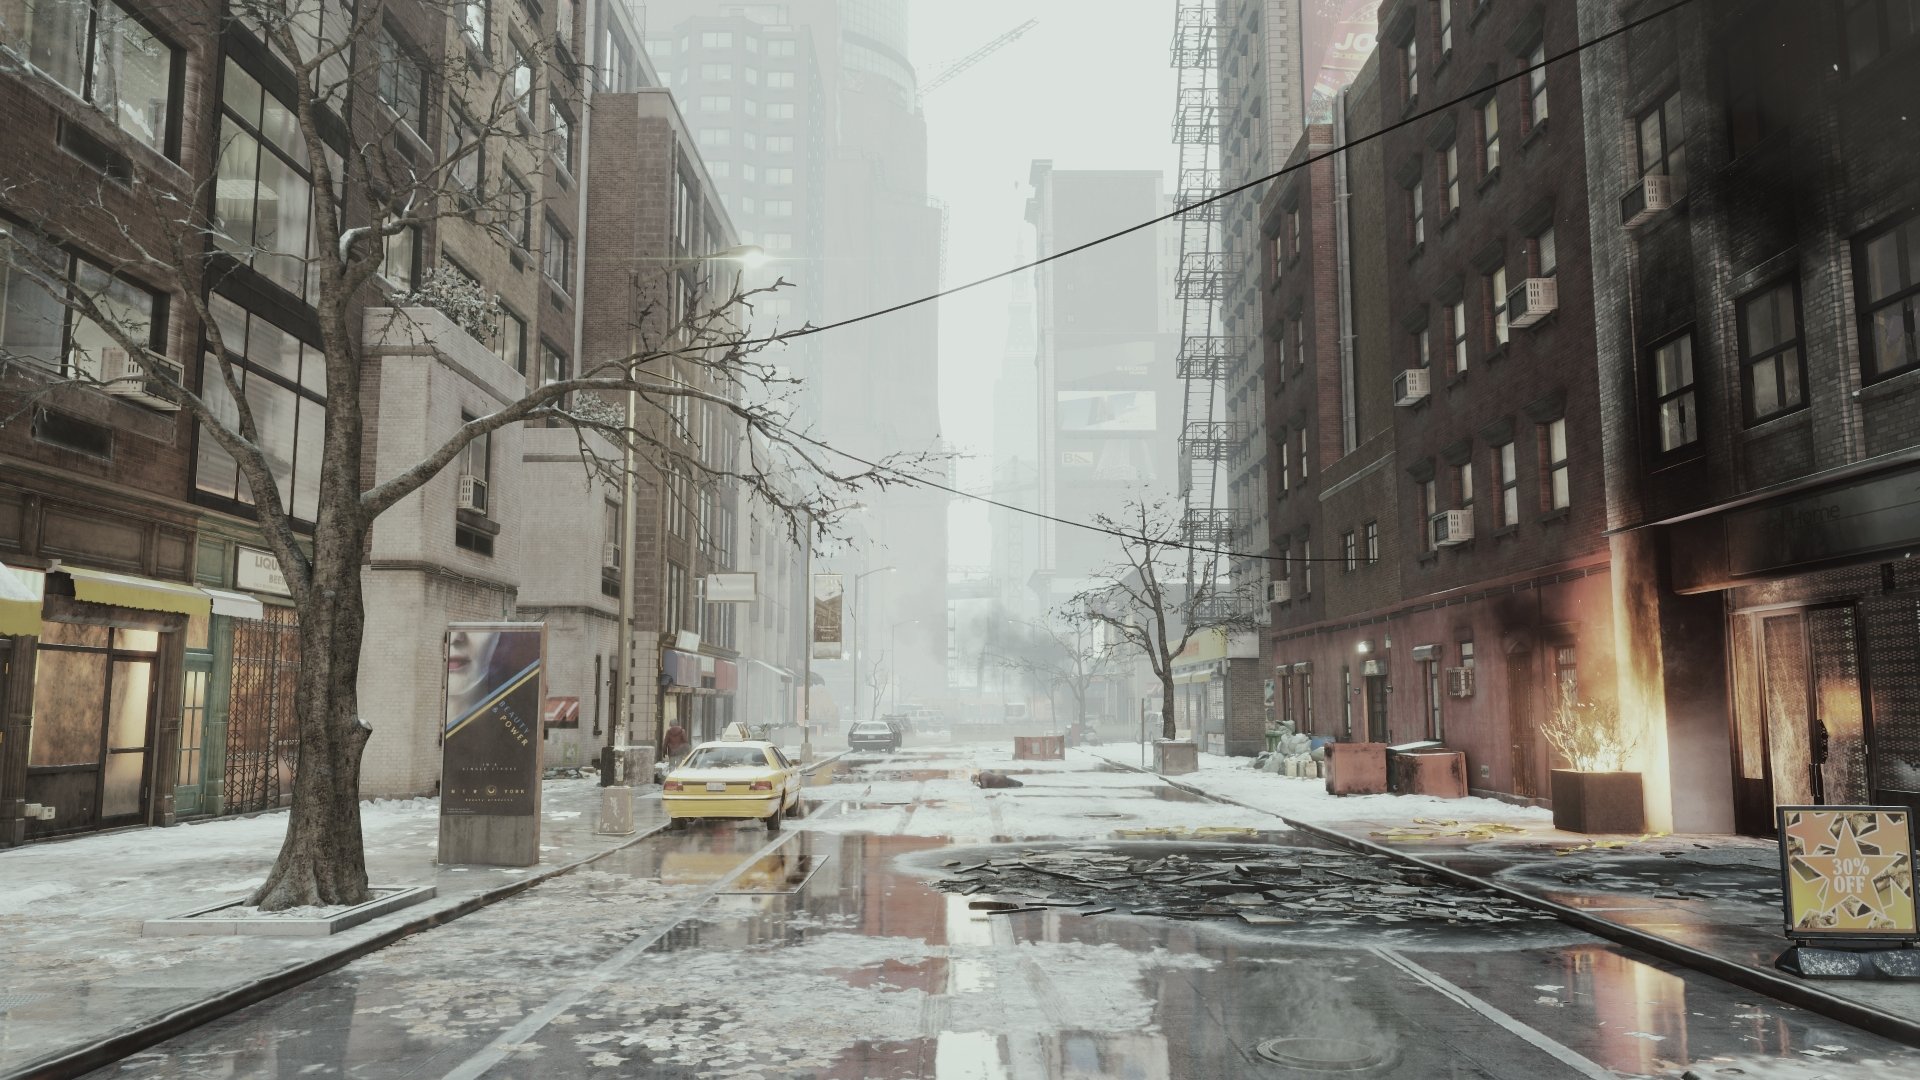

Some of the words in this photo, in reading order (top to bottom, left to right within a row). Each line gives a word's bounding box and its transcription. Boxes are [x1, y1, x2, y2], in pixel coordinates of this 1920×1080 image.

[498, 701, 530, 734] BEAUTY
[499, 714, 529, 747] POWER
[1832, 858, 1870, 876] 30%
[1833, 876, 1866, 894] OFF
